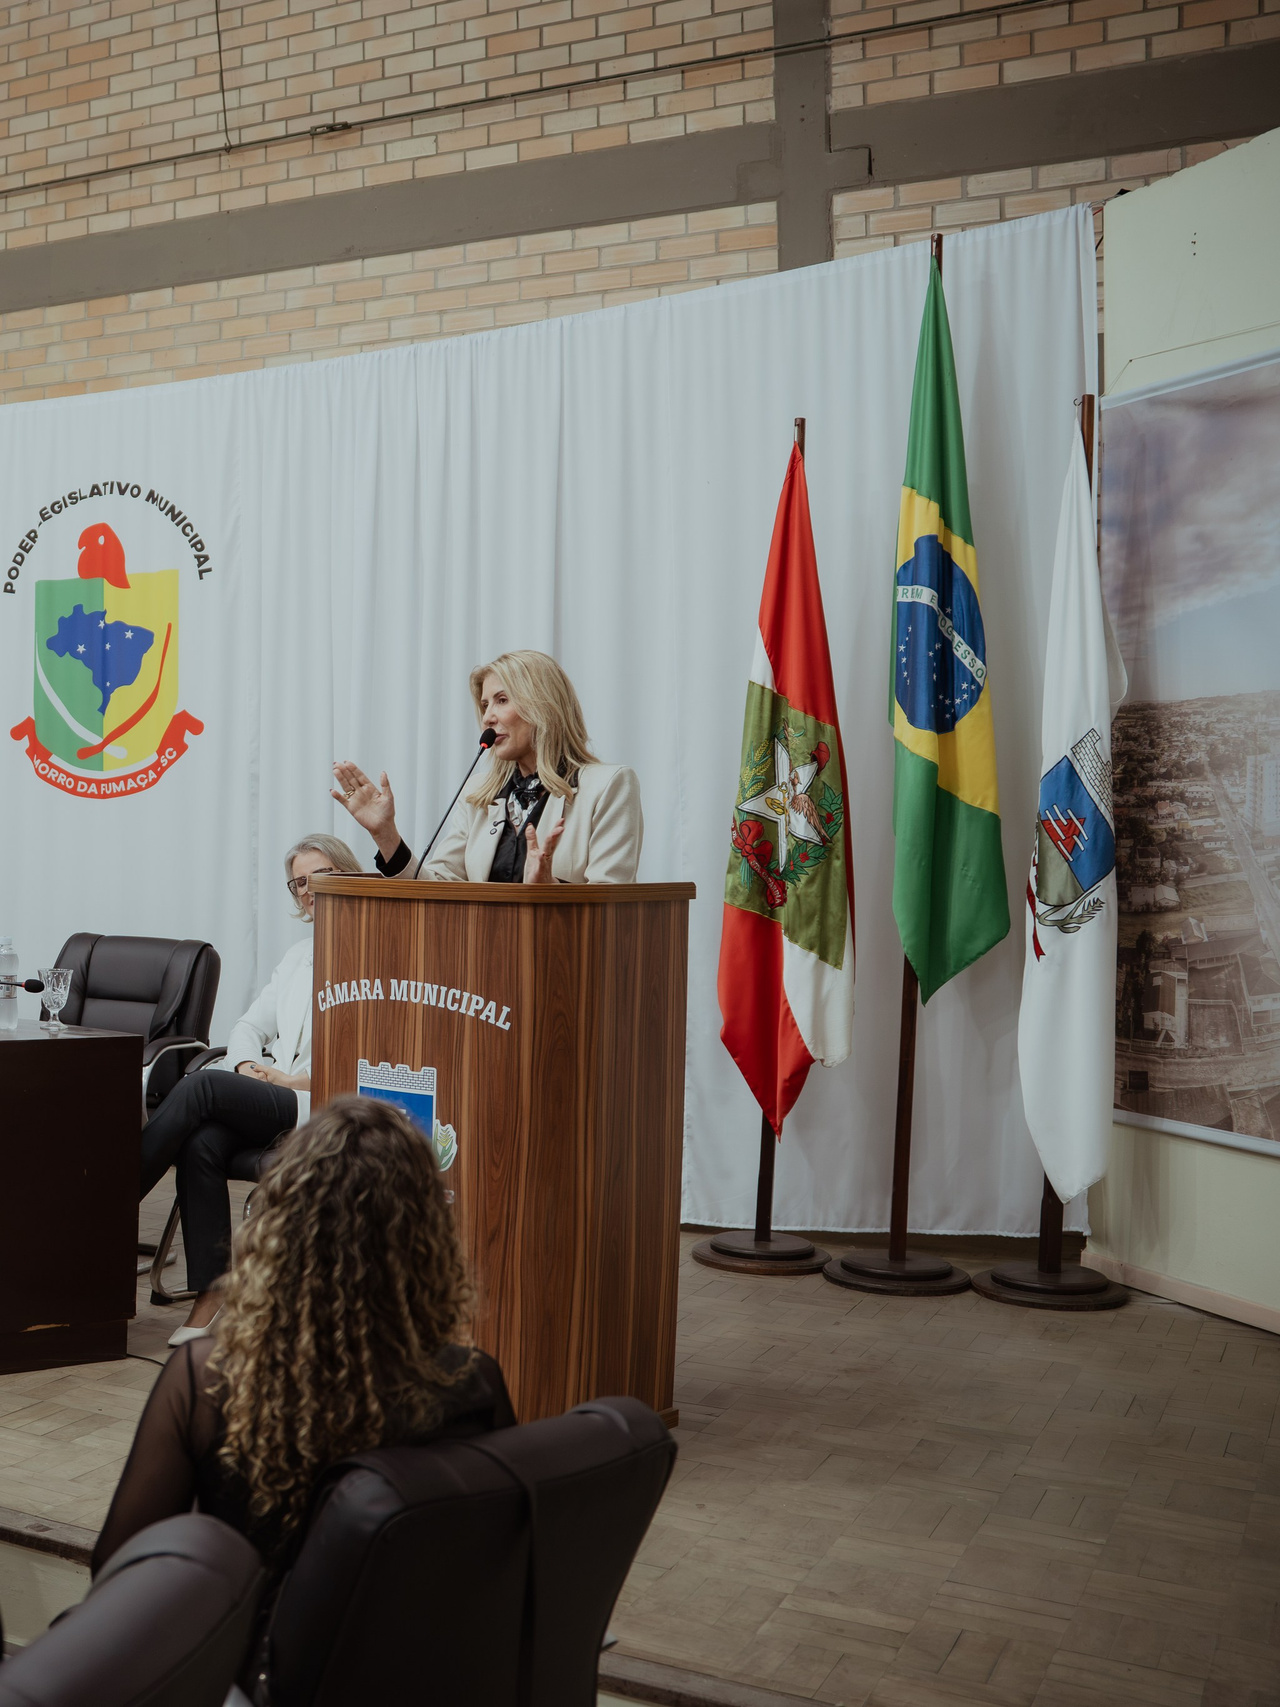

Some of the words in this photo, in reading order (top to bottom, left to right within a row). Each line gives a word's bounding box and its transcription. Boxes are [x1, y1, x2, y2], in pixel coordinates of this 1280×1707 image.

[3, 528, 39, 594] PODER
[38, 481, 142, 528] EGISLATIVO
[33, 754, 75, 789] MORRO
[76, 781, 99, 795] DA
[100, 769, 158, 795] FUMAÇA
[160, 747, 177, 768] SC
[317, 978, 385, 1012] CÂMARA
[390, 978, 512, 1031] MUNICIPAL
